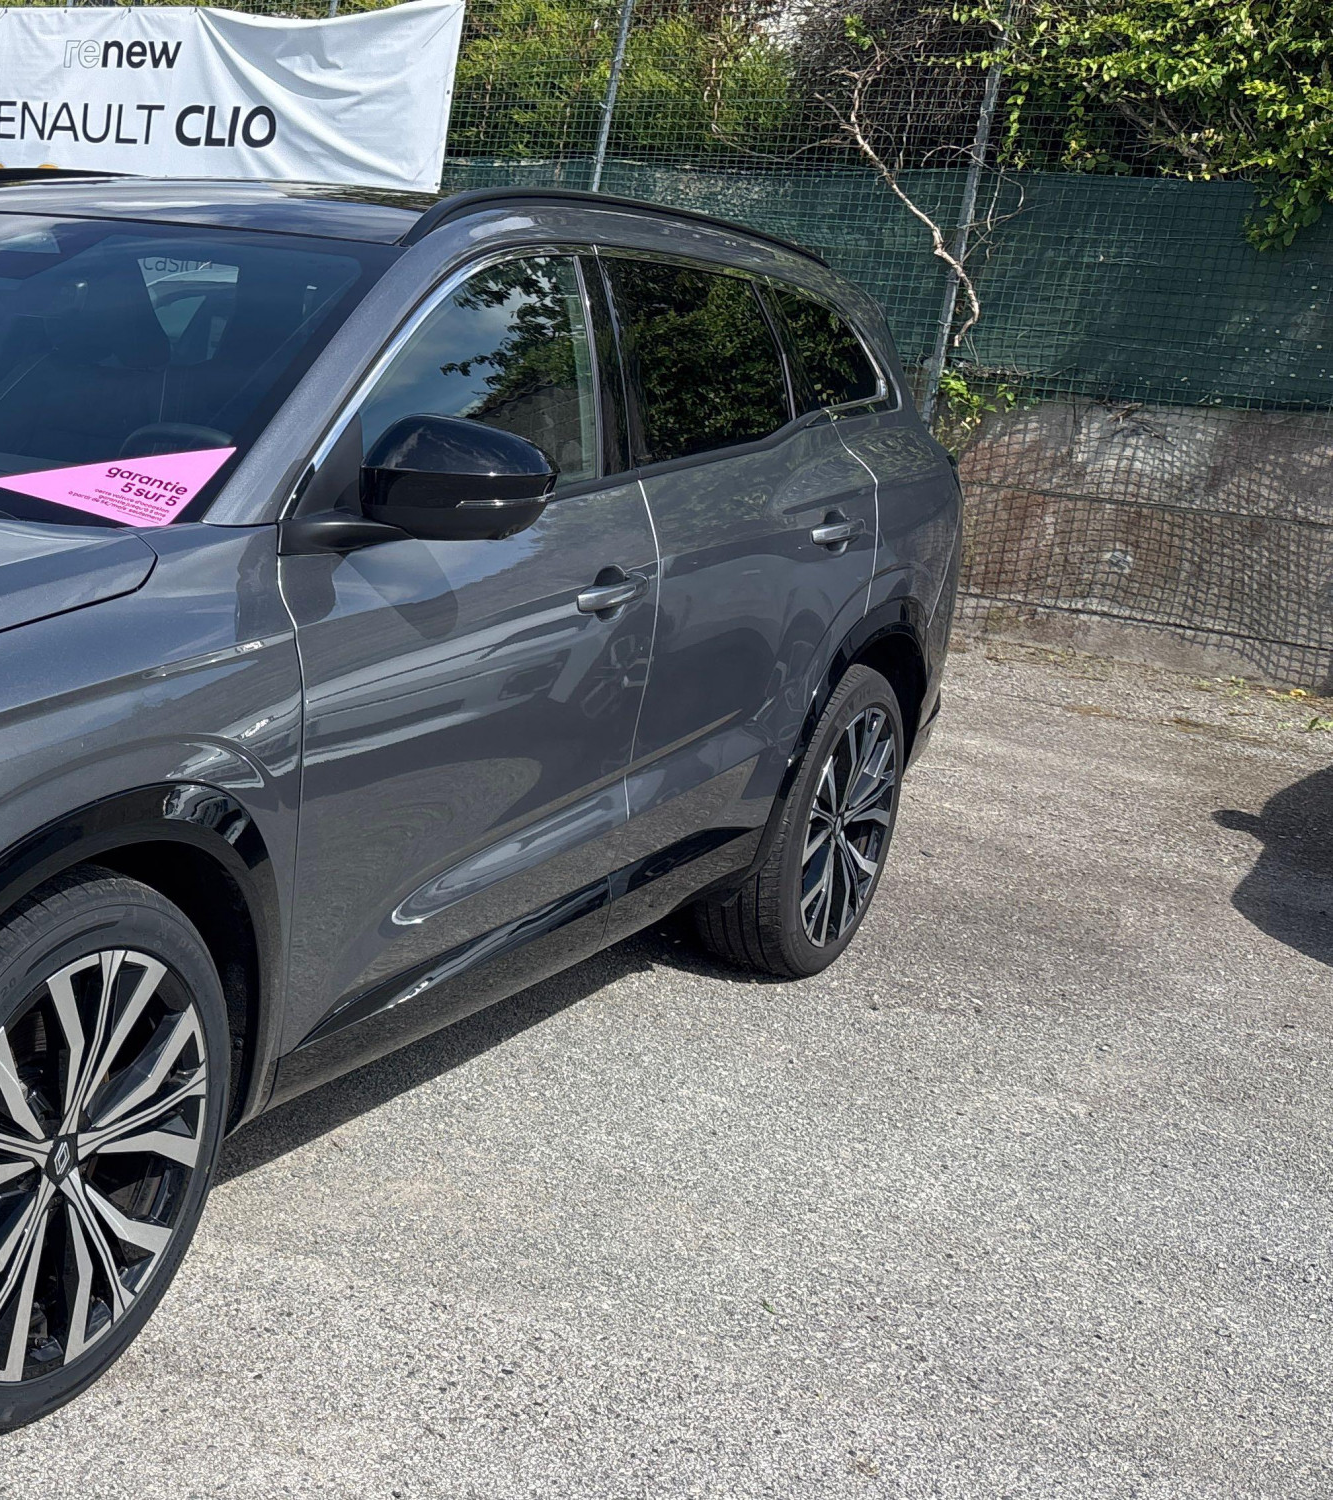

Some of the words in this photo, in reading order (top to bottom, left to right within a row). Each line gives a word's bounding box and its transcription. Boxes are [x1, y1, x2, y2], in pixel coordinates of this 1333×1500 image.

[63, 39, 182, 69] renew
[175, 104, 276, 148] CLIO
[105, 466, 188, 496] garantie
[120, 482, 136, 493] 5
[133, 487, 166, 502] sur
[165, 495, 180, 507] 5
